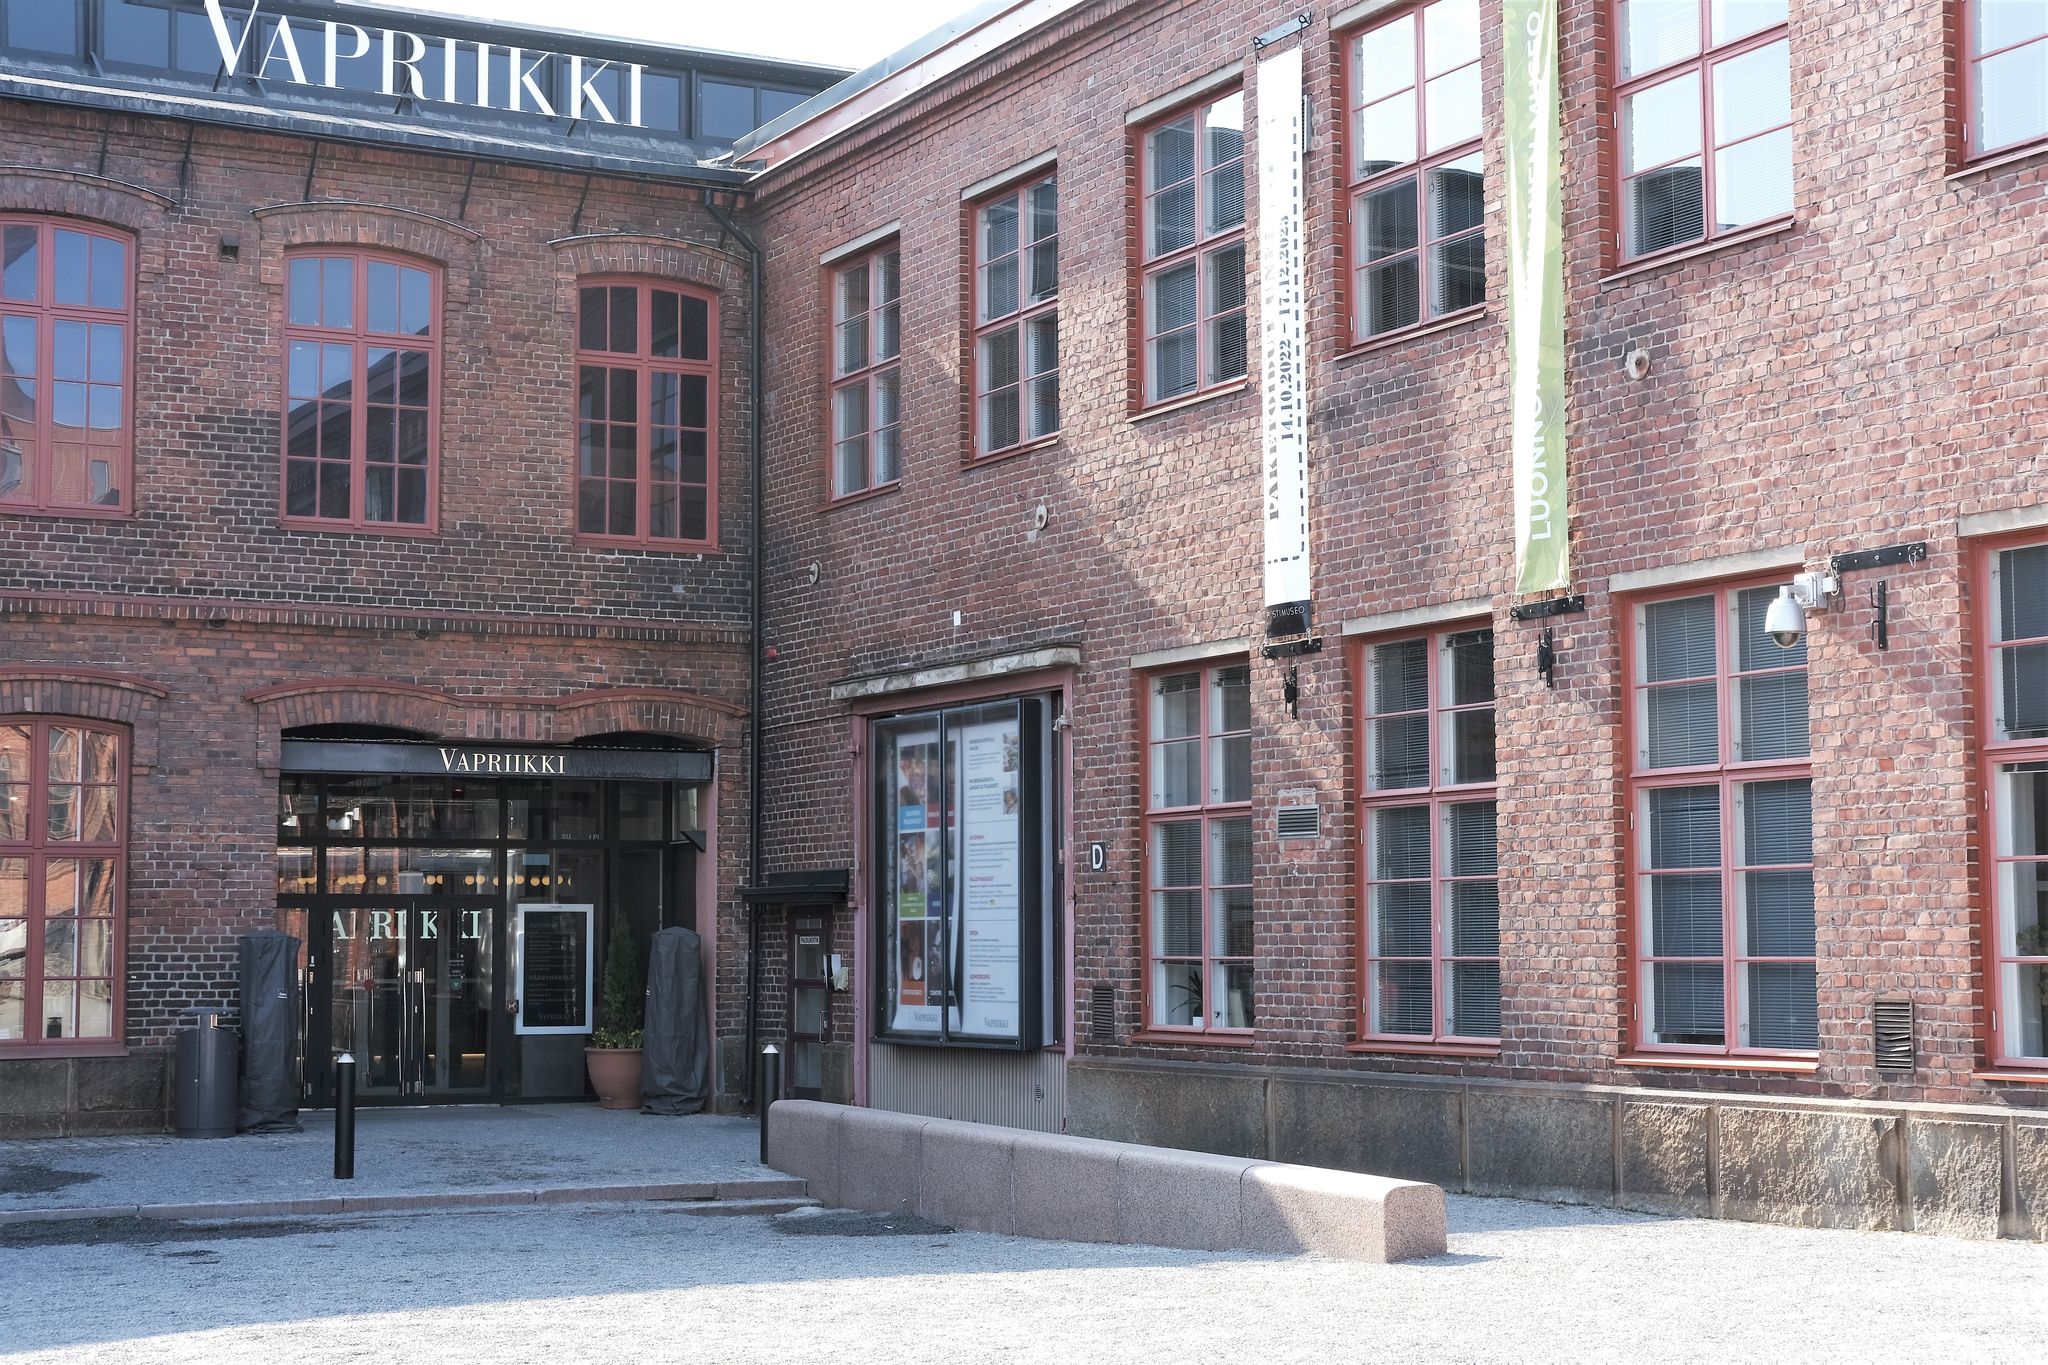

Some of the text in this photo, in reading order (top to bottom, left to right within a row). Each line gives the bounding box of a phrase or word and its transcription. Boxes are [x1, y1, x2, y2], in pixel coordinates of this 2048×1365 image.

[203, 0, 649, 128] VAPRIIKKI
[1279, 339, 1294, 440] 14.10.2022
[438, 748, 566, 774] VAPRIIKKI
[1092, 844, 1103, 869] D
